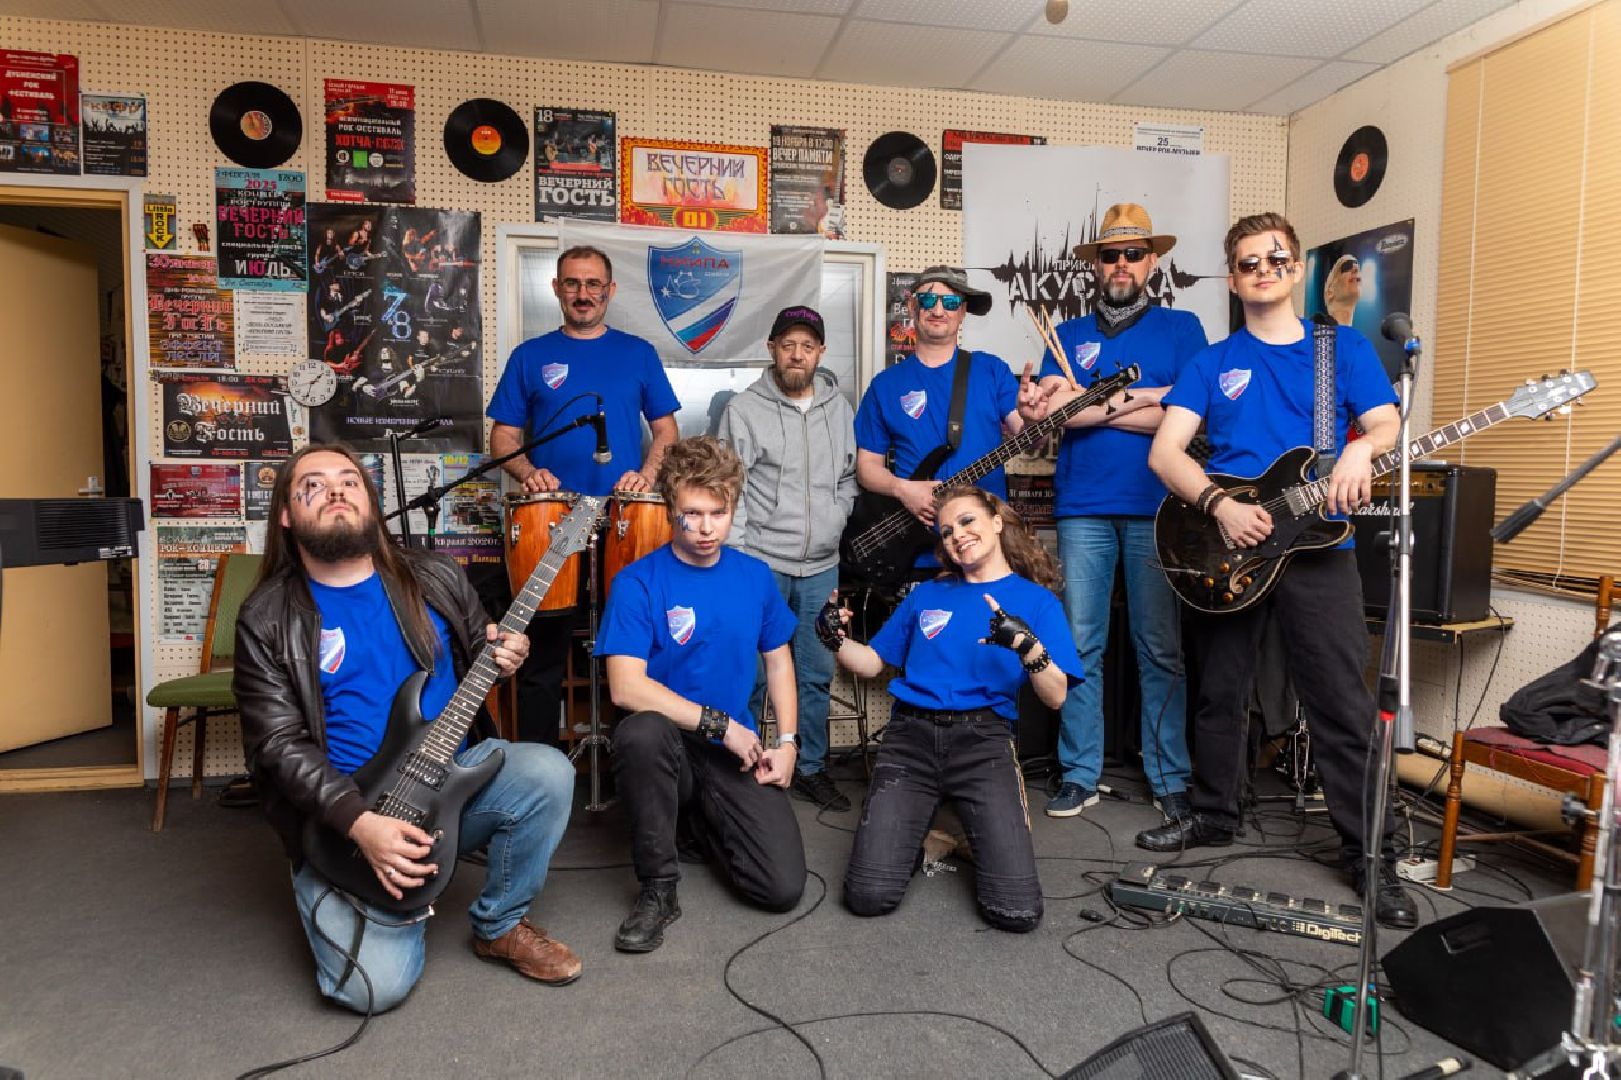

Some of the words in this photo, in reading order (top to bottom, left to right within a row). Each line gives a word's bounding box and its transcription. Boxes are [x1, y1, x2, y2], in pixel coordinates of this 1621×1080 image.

[536, 109, 553, 122] 18
[772, 148, 796, 160] ВЕЧЕР
[798, 149, 833, 163] ПАМЯТИ
[646, 153, 745, 179] ВЕЧЕРНИЙ
[538, 176, 613, 190] ВЕЧЕРНИЙ
[662, 177, 725, 201] ГОСТЬ
[539, 187, 615, 207] ГОСТЬ
[217, 205, 304, 225] ВЕЧЕРНИЙ
[156, 212, 165, 241] ROCK
[233, 221, 290, 240] ГОСТЬ
[1056, 260, 1095, 271] ПРИКЛ
[1009, 271, 1175, 301] АКУСКА
[176, 392, 281, 416] Вечерний
[194, 421, 265, 444] Гость
